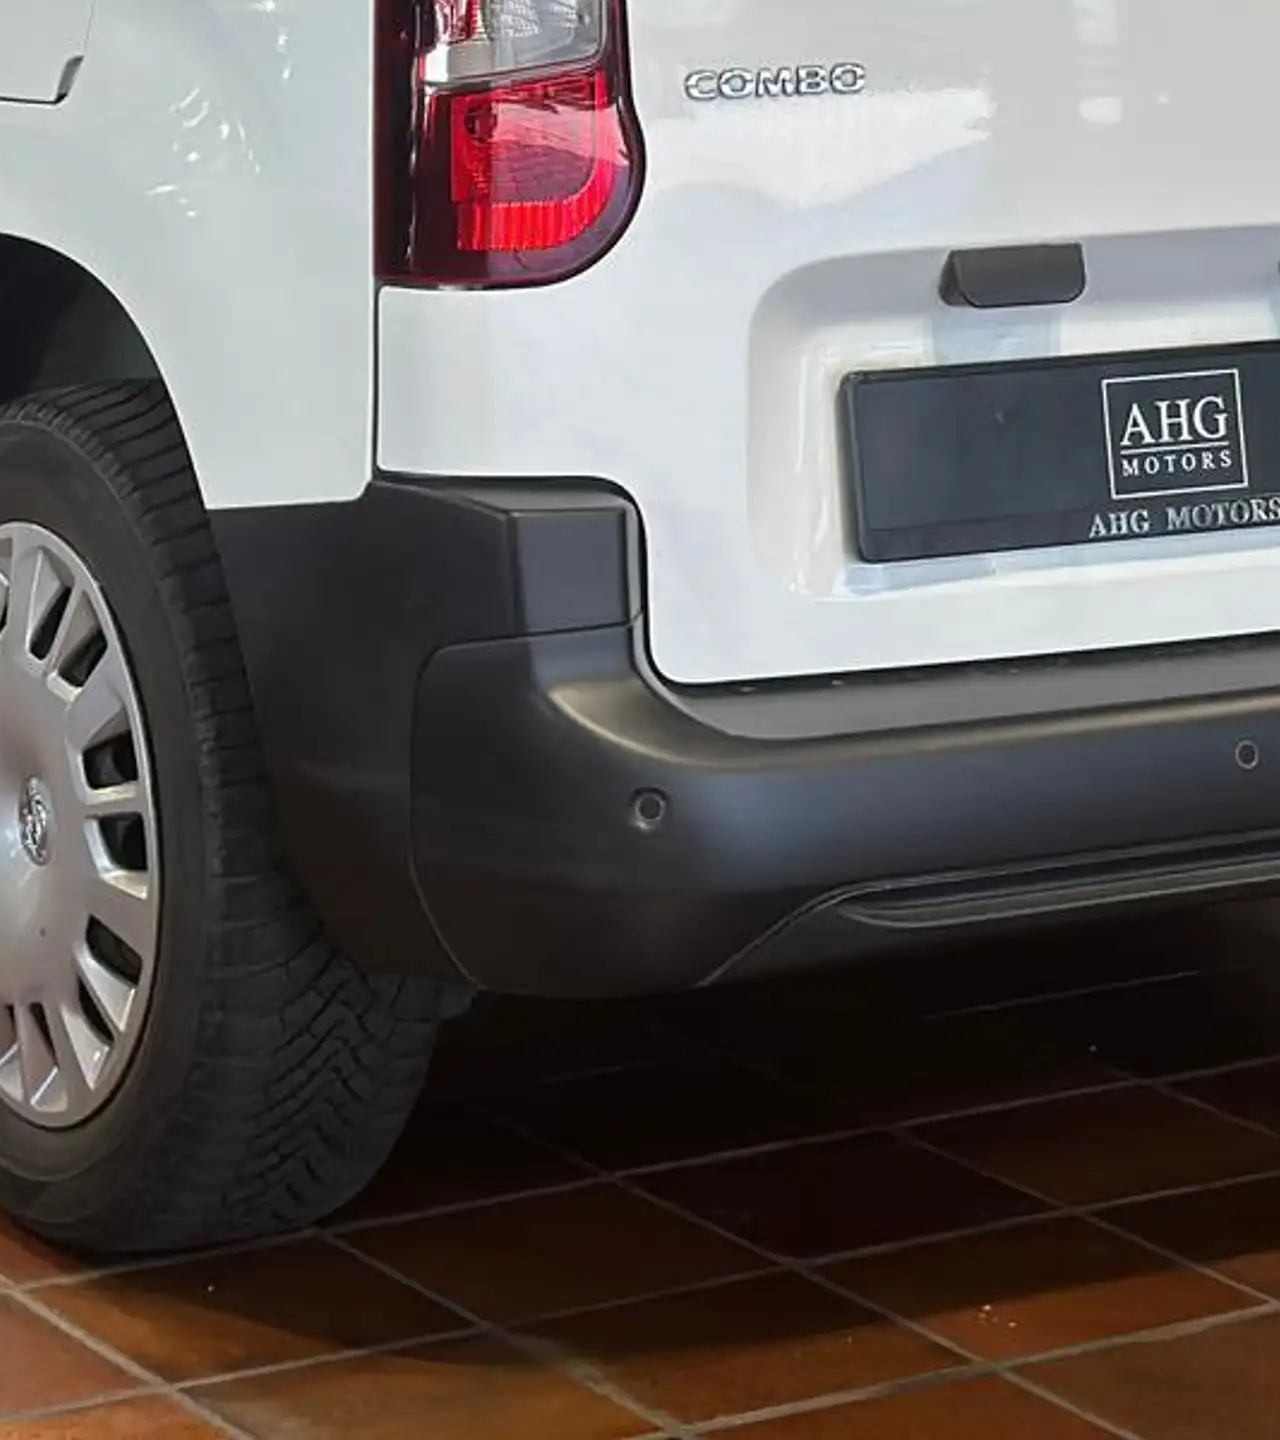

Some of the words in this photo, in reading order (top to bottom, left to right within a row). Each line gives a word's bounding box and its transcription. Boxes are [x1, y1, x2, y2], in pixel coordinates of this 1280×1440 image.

[684, 62, 866, 101] COMBO
[1120, 396, 1228, 445] AHG
[1122, 450, 1232, 476] MOTORS
[1089, 509, 1150, 538] AHG
